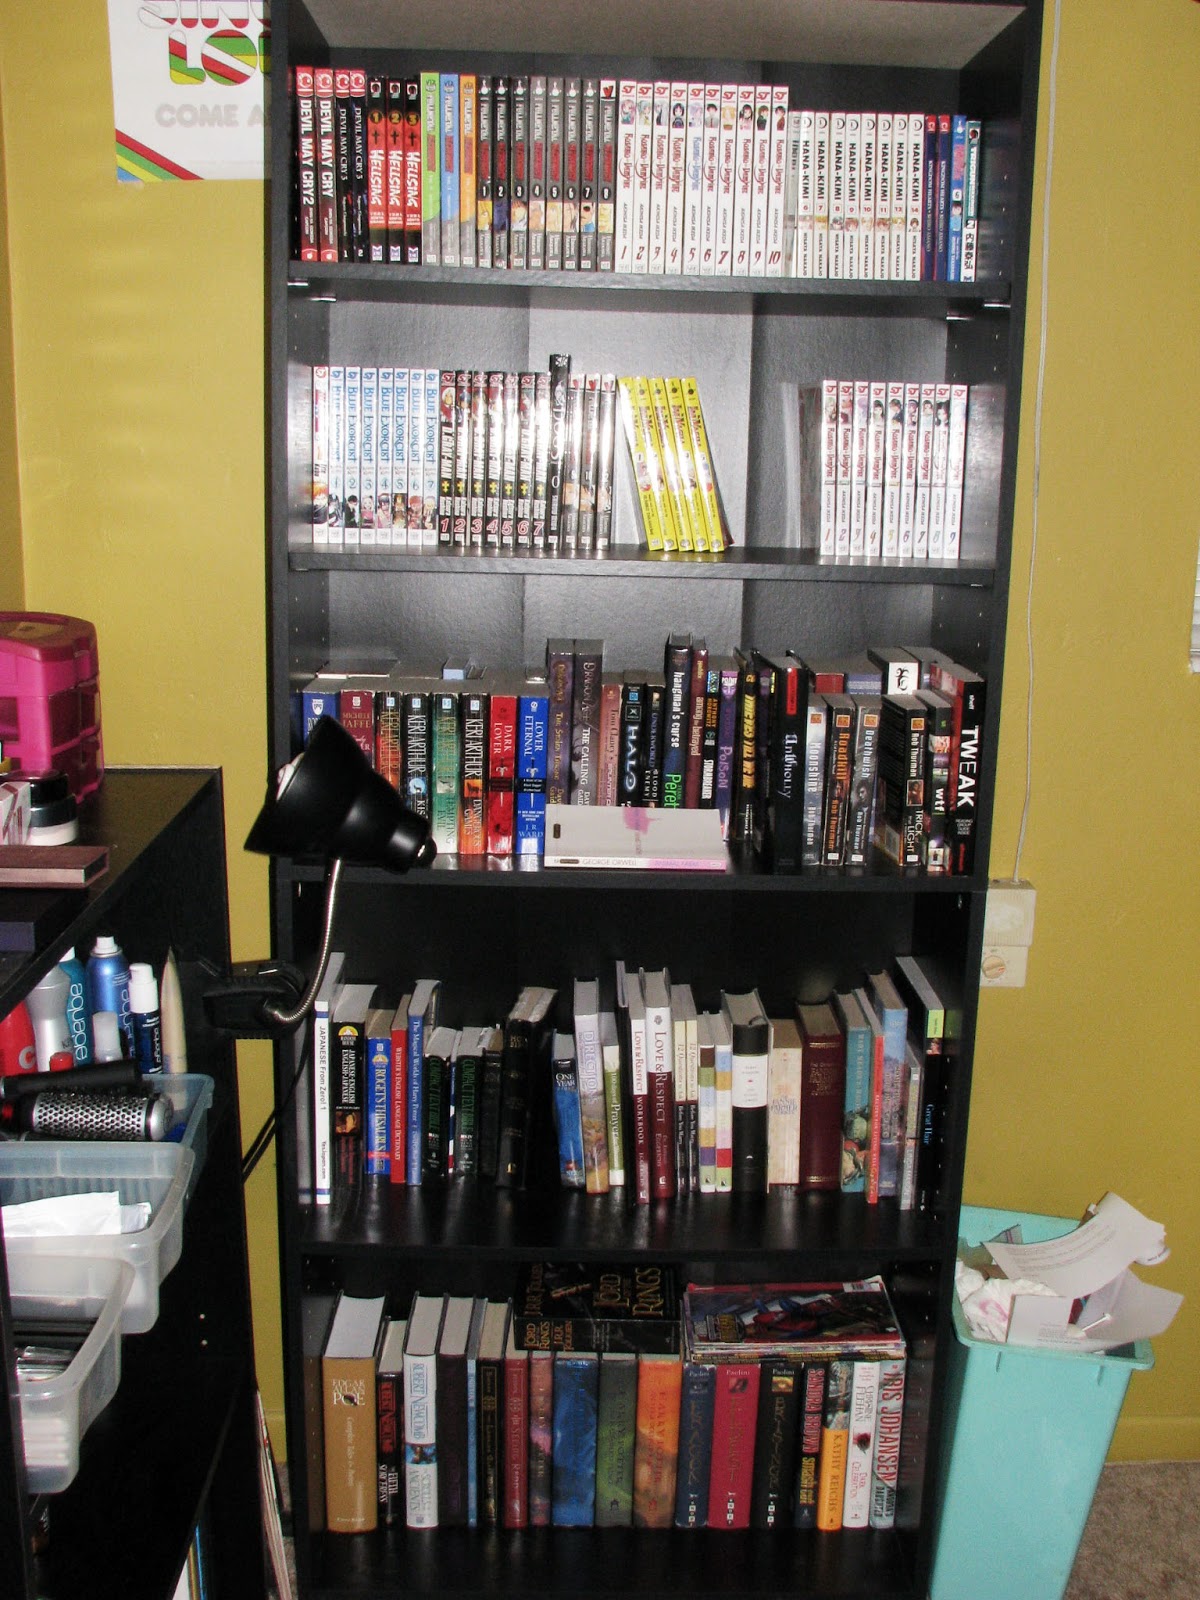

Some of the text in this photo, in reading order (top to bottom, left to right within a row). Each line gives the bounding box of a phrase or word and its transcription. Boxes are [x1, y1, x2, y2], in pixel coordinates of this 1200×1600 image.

[155, 104, 238, 128] COME
[300, 100, 312, 134] DEVIL
[320, 100, 331, 135] DEVIL
[301, 138, 313, 168] MAY
[321, 139, 332, 168] MAY
[340, 156, 348, 174] CRY
[355, 155, 363, 173] CRY
[802, 140, 810, 199] HANA-KIMI
[817, 140, 825, 200] HANA-KIMI
[322, 171, 333, 198] CRY
[369, 150, 385, 206] HELLSING
[388, 150, 403, 207] HELLSING
[406, 152, 420, 208] HELLSING
[881, 143, 889, 202] HANA-KIMI
[896, 142, 904, 201] HANA-KIMI
[912, 143, 920, 202] HANA-KIMI
[343, 250, 348, 258] 1
[441, 518, 449, 532] 1
[455, 519, 466, 533] 2
[471, 520, 483, 533] 3
[487, 520, 498, 533] 4
[502, 521, 513, 535] 5
[518, 521, 529, 534] 6
[534, 521, 544, 535] 7
[671, 672, 685, 748] hangman's curse
[693, 697, 704, 720] among
[408, 715, 426, 773] KERI ARTHUR
[464, 718, 483, 778] KERI ARTHUR
[494, 722, 502, 754] LOVER
[504, 725, 512, 752] DARK
[524, 715, 533, 757] ETERNAL
[534, 721, 544, 752] LOVER
[580, 727, 591, 785] THE CALLING
[625, 725, 638, 792] HALO
[807, 742, 820, 794] Moonshine
[837, 732, 850, 780] Roadkill
[861, 729, 874, 778] Deathwish
[910, 732, 919, 778] Rob Thurman
[957, 725, 979, 807] TWEAK
[664, 774, 682, 810] Peret
[934, 788, 945, 813] wtf
[437, 810, 446, 830] EVIL
[446, 797, 455, 844] TEMPTING
[464, 808, 472, 835] GAMES
[472, 799, 482, 847] DANGEROUS
[829, 816, 838, 849] Thurman
[854, 824, 862, 850] Thurman
[915, 810, 924, 836] TRICK
[906, 825, 915, 853] LIGHT
[583, 858, 610, 866] GEORGE
[634, 1031, 643, 1054] LOVE
[655, 1032, 667, 1063] LOVE
[556, 1072, 575, 1081] ONE
[556, 1080, 575, 1088] YEAR
[635, 1059, 644, 1093] RESPECT
[374, 1069, 387, 1151] ROGET'S THESAURUS
[656, 1073, 667, 1123] RESPECT
[610, 1103, 621, 1136] Prayer
[636, 1095, 644, 1144] WORKBOOK
[923, 1104, 934, 1145] Great Hair
[632, 1267, 664, 1317] RINGS
[332, 1379, 365, 1387] EDGAR
[332, 1386, 365, 1394] ALLAN
[410, 1363, 426, 1440] ROBERT NEWCOMB
[802, 1368, 825, 1453] SANDRA BROWN
[856, 1386, 866, 1422] FEEHAN
[877, 1372, 903, 1482] IRIS JOHANSEN
[379, 1464, 388, 1503] SORCERESS
[388, 1473, 398, 1494] FIFTH
[828, 1434, 842, 1510] KATHY REICHS
